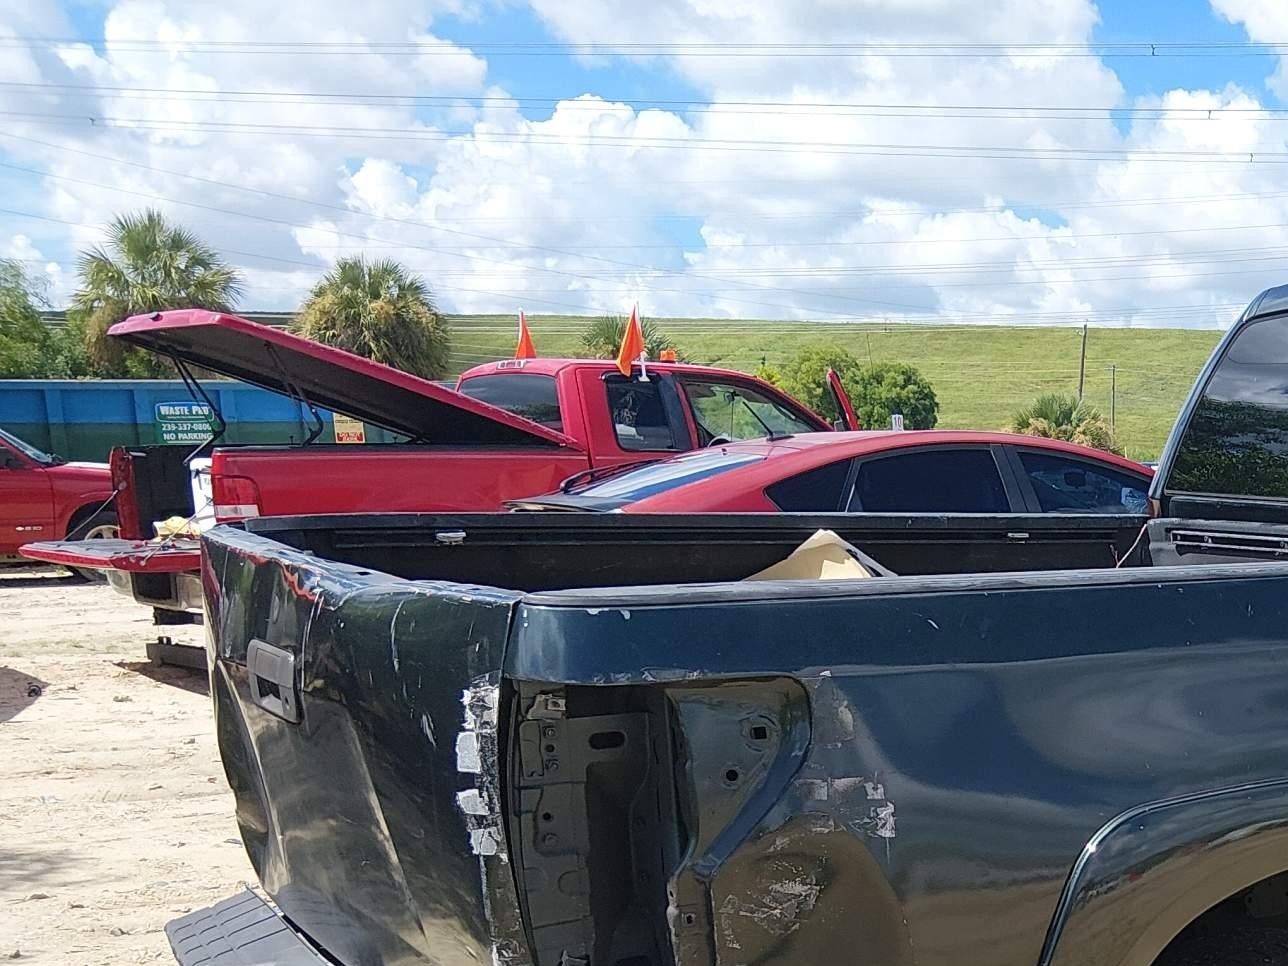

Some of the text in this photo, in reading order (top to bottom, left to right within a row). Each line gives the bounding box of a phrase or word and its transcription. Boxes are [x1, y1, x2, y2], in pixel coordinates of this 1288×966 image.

[159, 405, 190, 415] WASTE
[163, 432, 213, 440] NO PARKING
